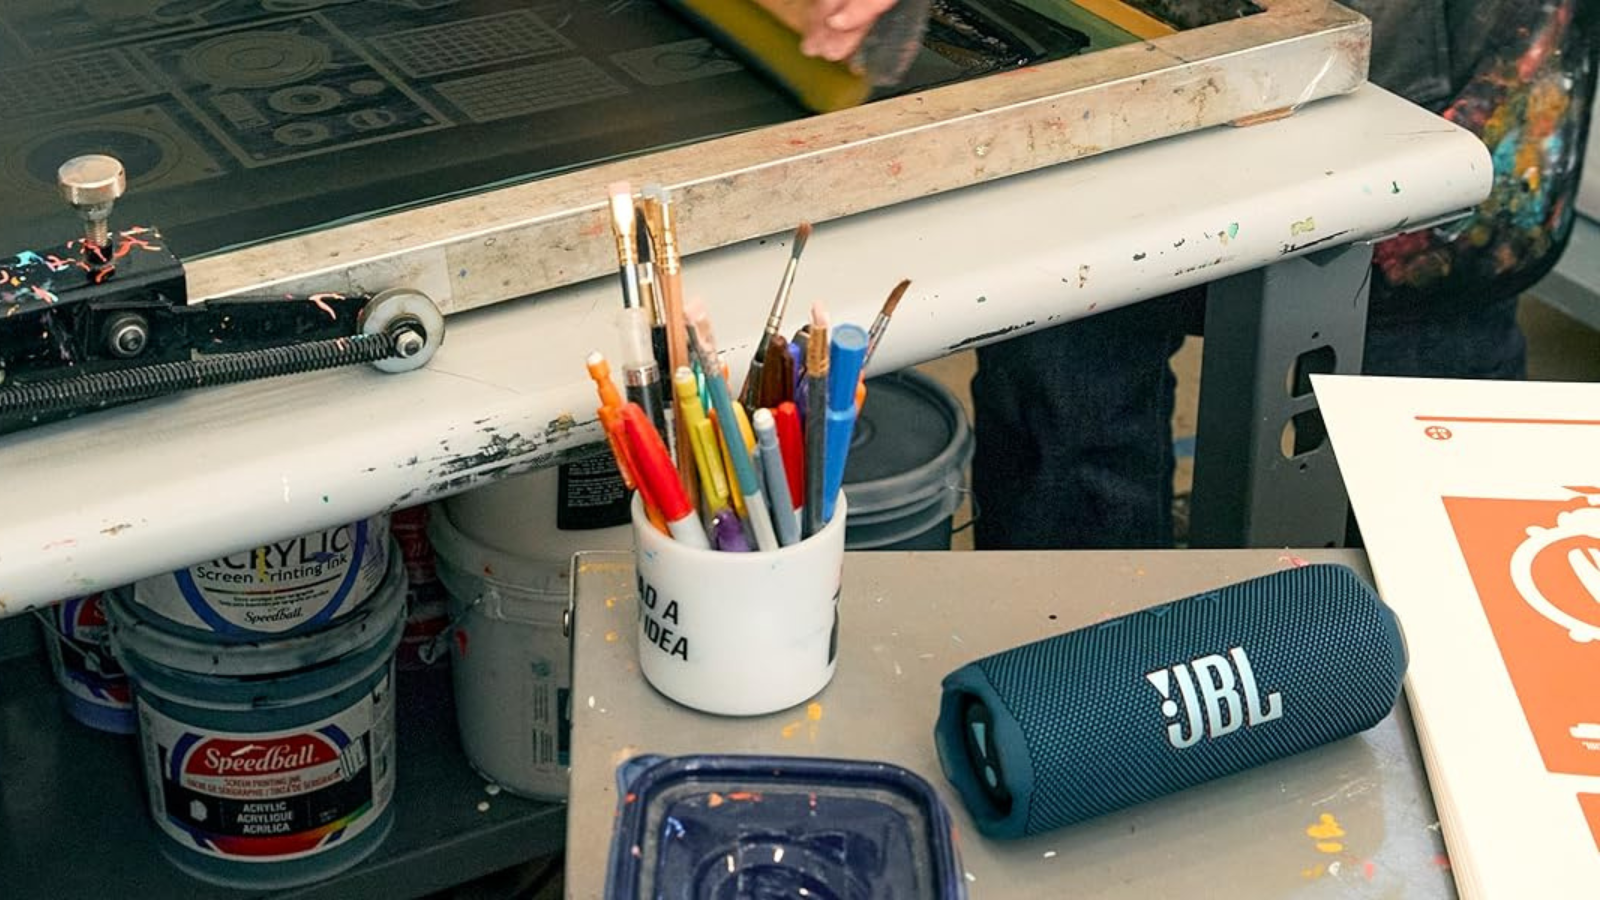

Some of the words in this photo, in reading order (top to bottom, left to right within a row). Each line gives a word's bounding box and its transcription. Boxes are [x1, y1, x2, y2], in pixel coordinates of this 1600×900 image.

[197, 566, 253, 583] Screen
[259, 564, 322, 583] rinting
[326, 554, 348, 571] Ink
[637, 571, 657, 610] AD
[662, 600, 678, 625] A
[244, 607, 302, 624] Speedball
[644, 613, 688, 661] IDEA
[1150, 646, 1283, 748] JBL
[204, 743, 315, 774] Speedball
[237, 811, 293, 823] ACRYLIQUE
[242, 802, 287, 813] ACRYLIC
